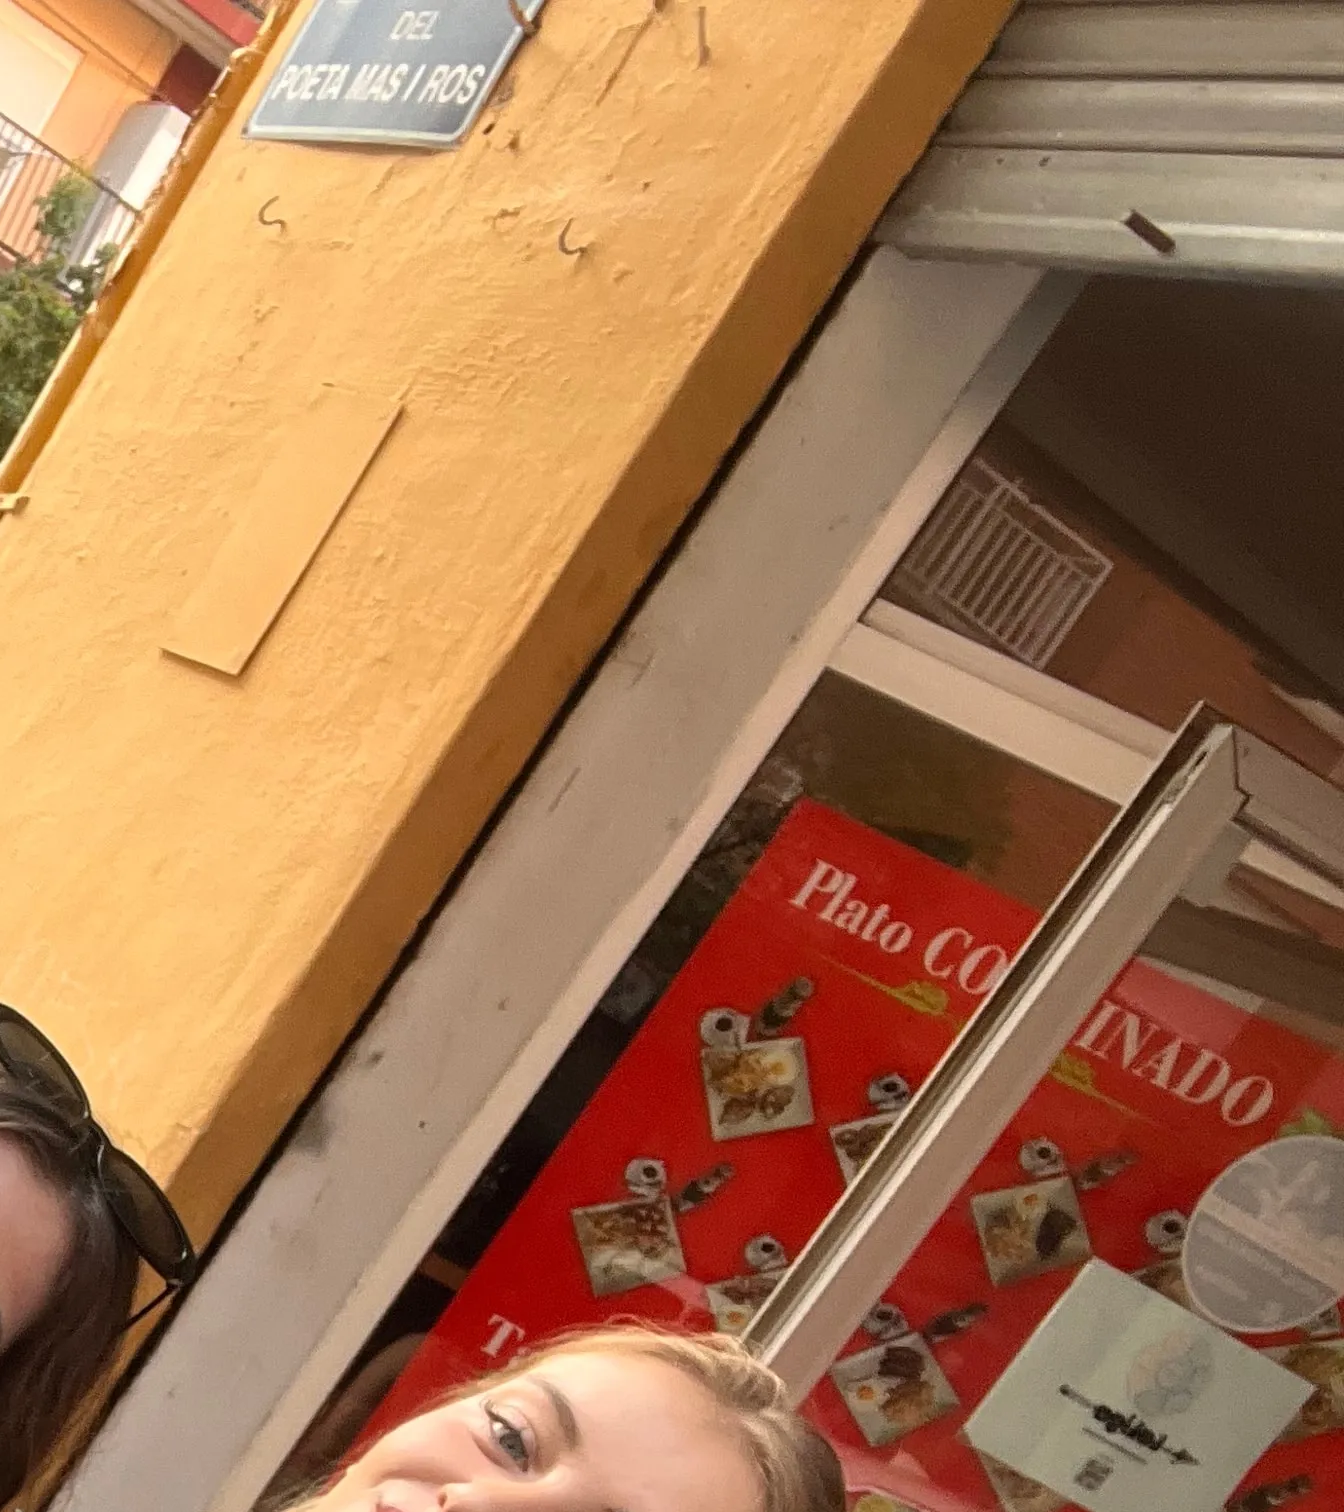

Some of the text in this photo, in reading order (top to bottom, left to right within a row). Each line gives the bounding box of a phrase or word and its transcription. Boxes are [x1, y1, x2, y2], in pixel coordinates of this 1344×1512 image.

[389, 10, 440, 41] DEL
[271, 63, 351, 101] POETA
[344, 63, 409, 101] MAS
[418, 63, 486, 104] ROS
[789, 857, 1275, 1127] Plato COINADO
